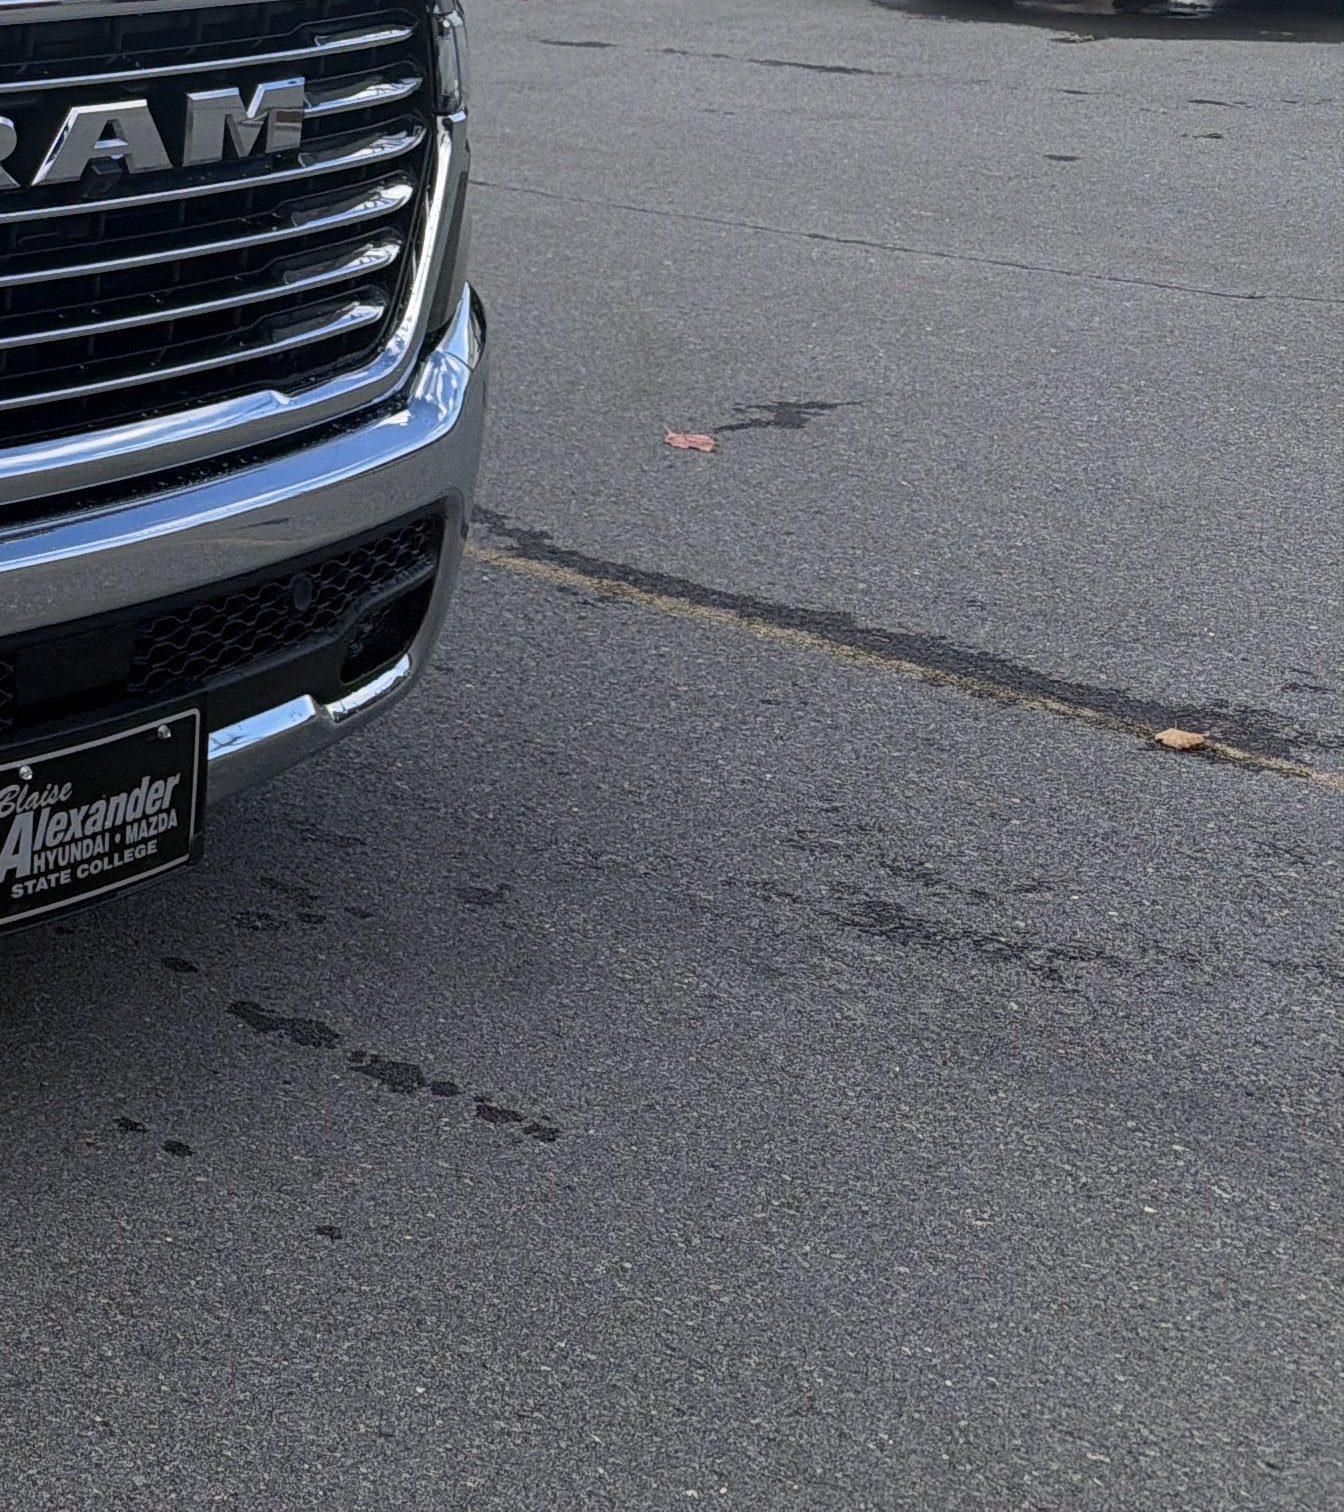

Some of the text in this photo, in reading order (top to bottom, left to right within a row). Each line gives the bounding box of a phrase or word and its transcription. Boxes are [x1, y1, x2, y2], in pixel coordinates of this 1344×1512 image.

[11, 839, 157, 898] STATE COLLEGE
[33, 808, 178, 874] HYUNDAI MAZDA
